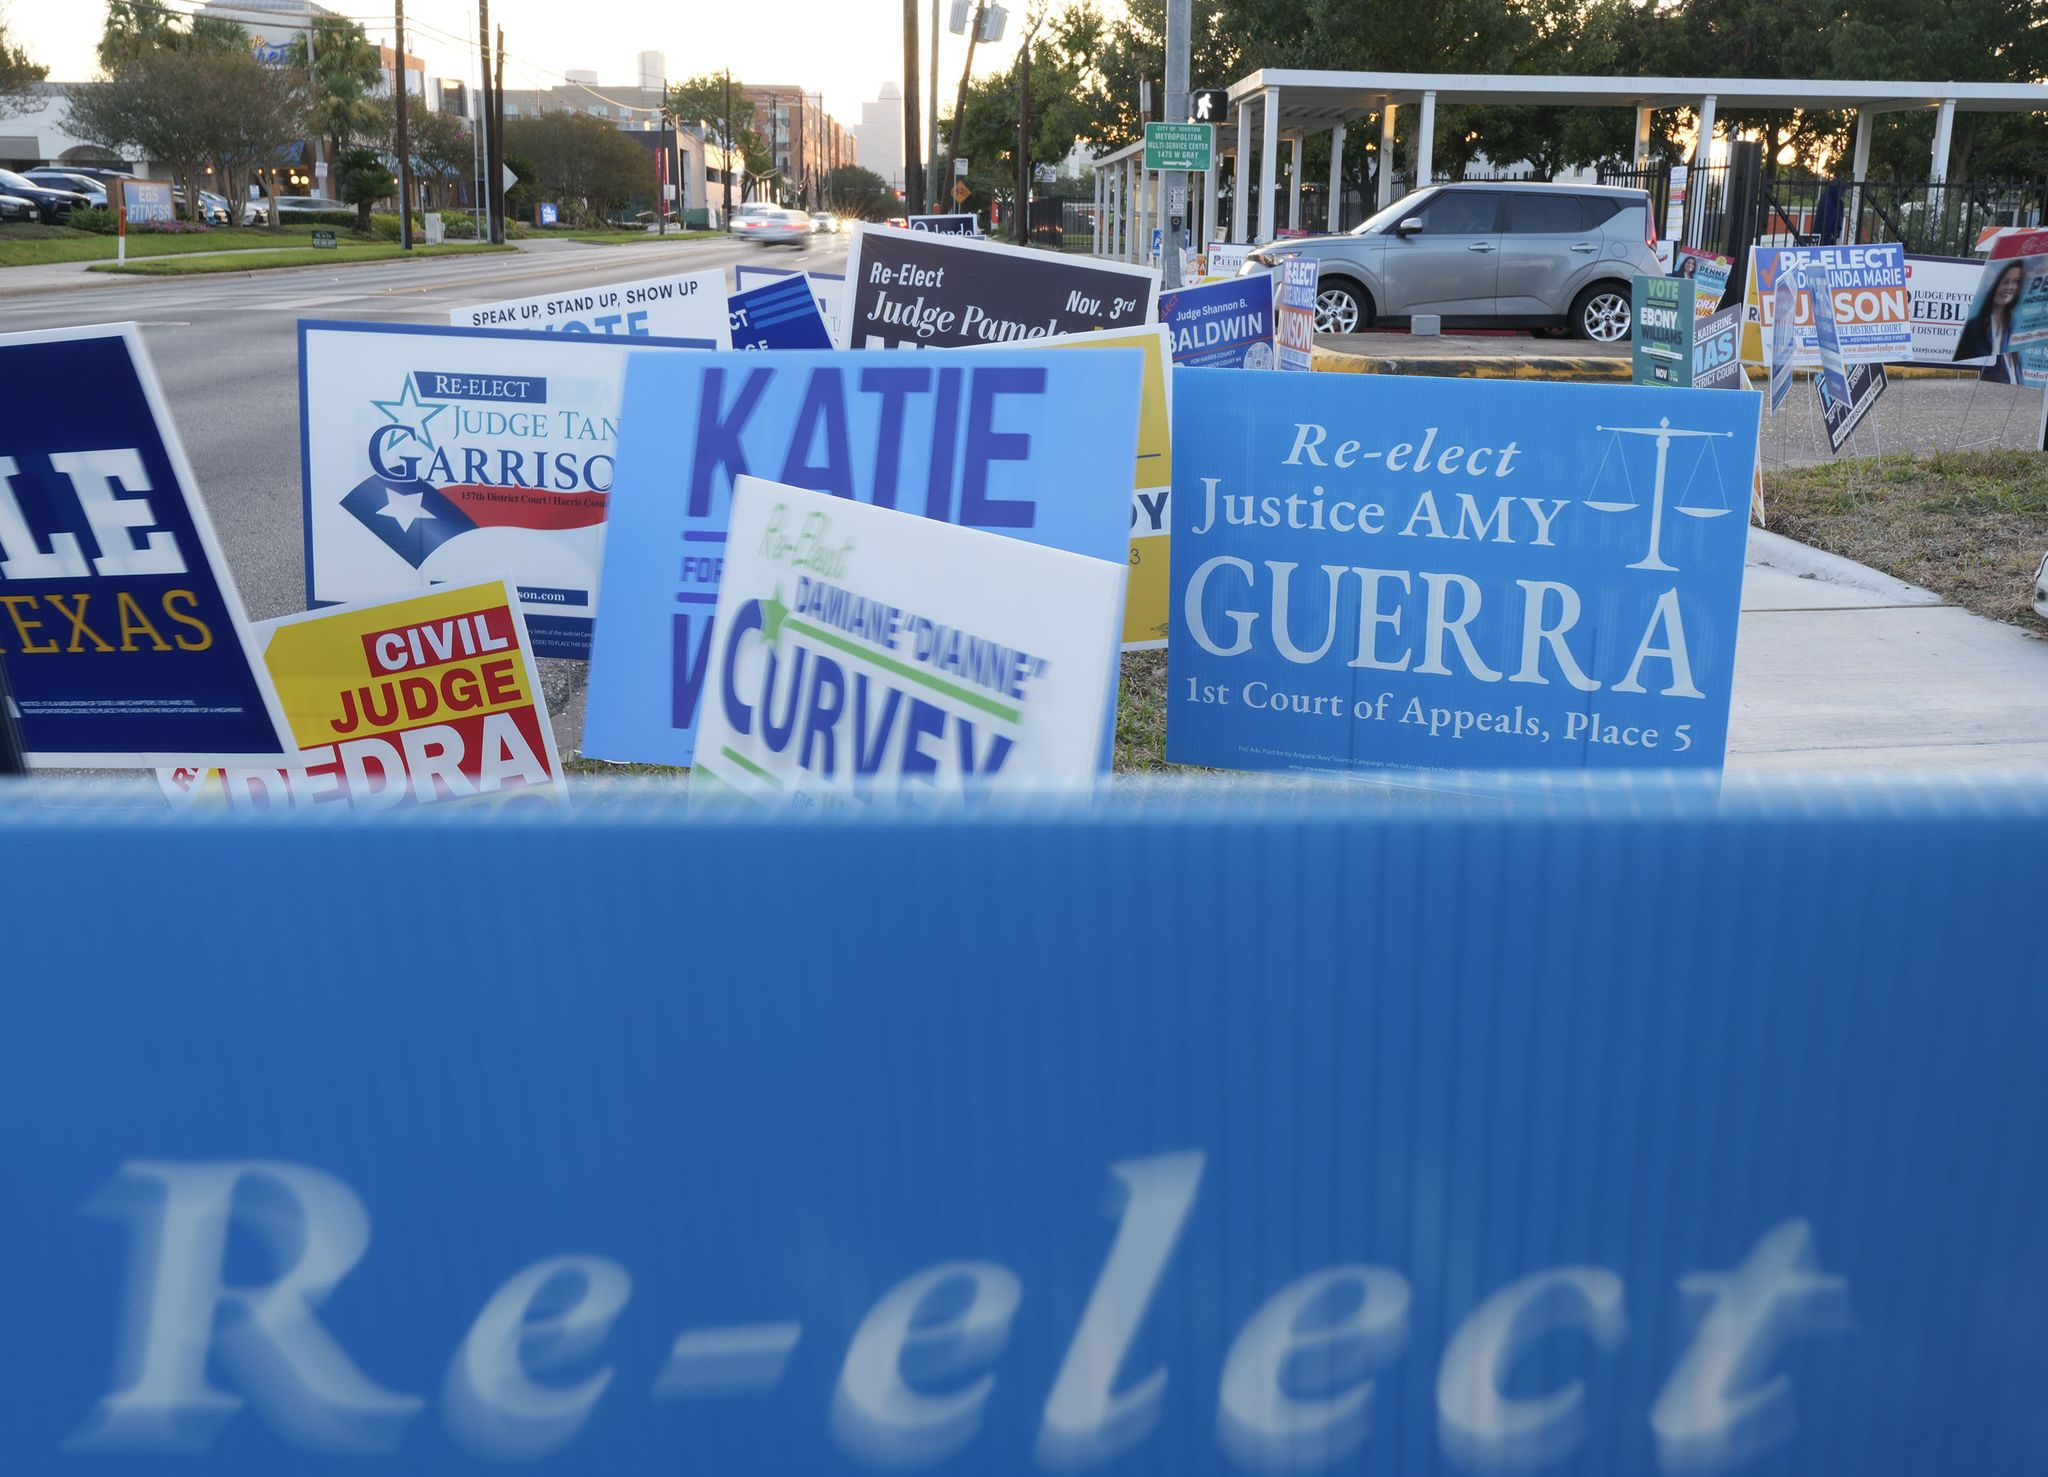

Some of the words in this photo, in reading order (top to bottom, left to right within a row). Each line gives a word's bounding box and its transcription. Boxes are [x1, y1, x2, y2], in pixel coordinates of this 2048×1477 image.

[1148, 142, 1187, 150] MULTI-SERVICE
[1188, 143, 1209, 151] CENTER
[1155, 133, 1202, 141] METROPOLITAN
[1182, 151, 1199, 159] GRAY
[130, 204, 170, 220] FITNESS
[1780, 248, 1897, 271] RE-ELECT
[1700, 266, 1727, 278] PENNY
[1864, 269, 1902, 286] MARIE
[869, 262, 944, 288] Re-Elect
[1065, 290, 1102, 317] Nov.
[1109, 297, 1136, 319] 3rd
[1648, 279, 1679, 299] VOTE
[1914, 290, 1944, 301] JUDGE
[1946, 292, 1975, 301] PEYTO
[472, 307, 517, 326] SPEAK
[520, 304, 542, 320] UP,
[547, 296, 594, 316] STAND
[599, 293, 621, 308] UP,
[626, 284, 673, 304] SHOW
[679, 280, 698, 297] UP
[867, 290, 955, 338] Judge
[1176, 309, 1201, 321] Judge
[1202, 302, 1238, 316] Shannon
[1239, 298, 1248, 308] B.
[1913, 301, 1969, 321] EEBL
[1640, 307, 1678, 330] EBONY
[1697, 313, 1733, 340] KATHERINE
[1851, 325, 1879, 334] DISTRICT
[1881, 324, 1902, 333] COURT
[1641, 325, 1683, 346] WILLIAMS
[1921, 327, 1957, 337] DISTRICT
[1217, 350, 1236, 359] COUNTY
[1655, 367, 1668, 379] NOV
[1716, 363, 1739, 381] COURT
[434, 374, 530, 399] RE-ELECT
[452, 405, 548, 440] JUDGE
[558, 410, 621, 441] TAN
[368, 424, 615, 492] GARRISO
[685, 367, 1048, 529] KATIE
[1282, 423, 1522, 478] Re-elect
[462, 491, 485, 501] 157th
[487, 493, 519, 503] District
[521, 495, 547, 505] Court
[553, 496, 582, 507] Harris
[584, 498, 606, 508] Coun
[0, 448, 189, 580] LE
[1192, 477, 1385, 535] Justice
[1398, 489, 1572, 547] AMY
[518, 591, 565, 601] son.com
[0, 589, 213, 654] EXAS
[1184, 555, 1707, 699] GUERRA
[375, 614, 508, 671] CIVIL
[330, 658, 523, 734] JUDGE
[1186, 677, 1230, 705] 1st
[1243, 681, 1343, 718] Court
[1353, 691, 1395, 721] of
[1400, 696, 1551, 744] Appeals,
[1563, 711, 1659, 749] Place
[1672, 723, 1692, 752] 5
[70, 1150, 1850, 1468] Re-elect
